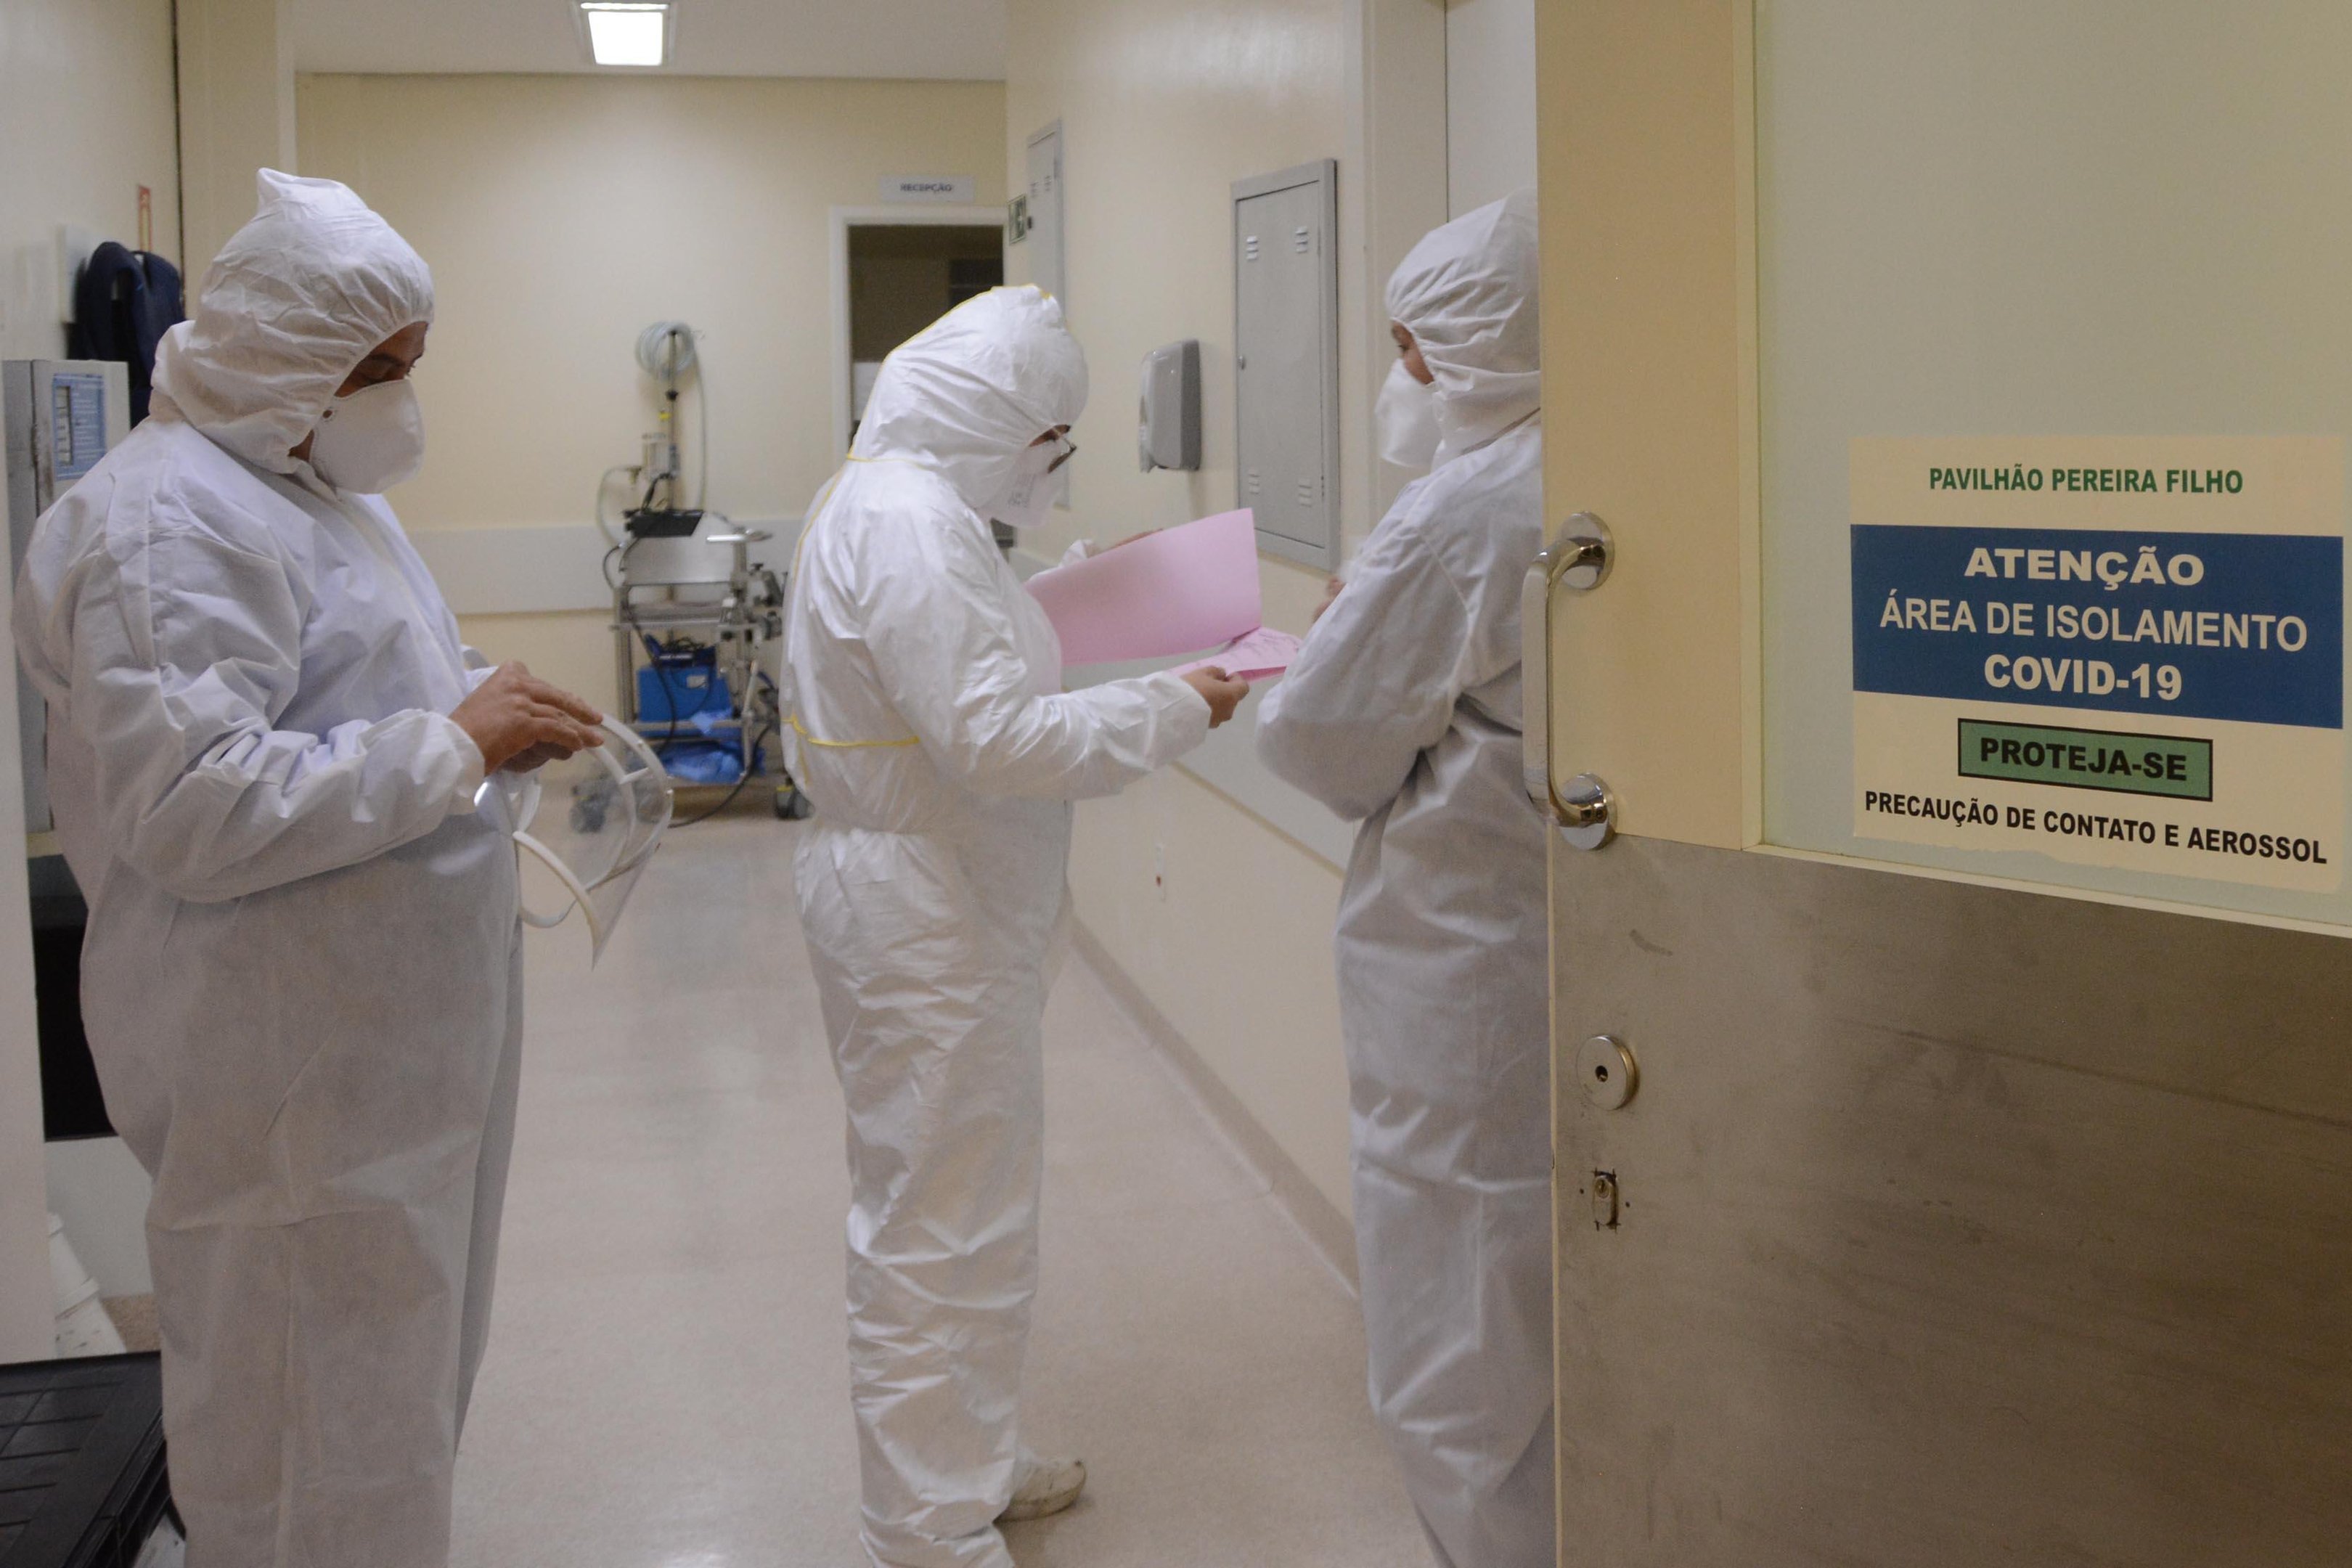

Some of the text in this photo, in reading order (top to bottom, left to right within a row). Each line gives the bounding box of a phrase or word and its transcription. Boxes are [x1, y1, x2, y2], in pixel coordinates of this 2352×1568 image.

[1930, 463, 2243, 494] PAVILHÃO PEREIRA FILHO
[1964, 546, 2205, 590] ATENÇÃO
[1879, 589, 2307, 651] ÁREA DE ISOLAMENTO
[1984, 655, 2182, 701] COVID-19
[1980, 737, 2187, 781] PROTEJA-SE
[1866, 791, 2327, 864] PRECAUÇÃO DE CONTATO E AEROSSOL
